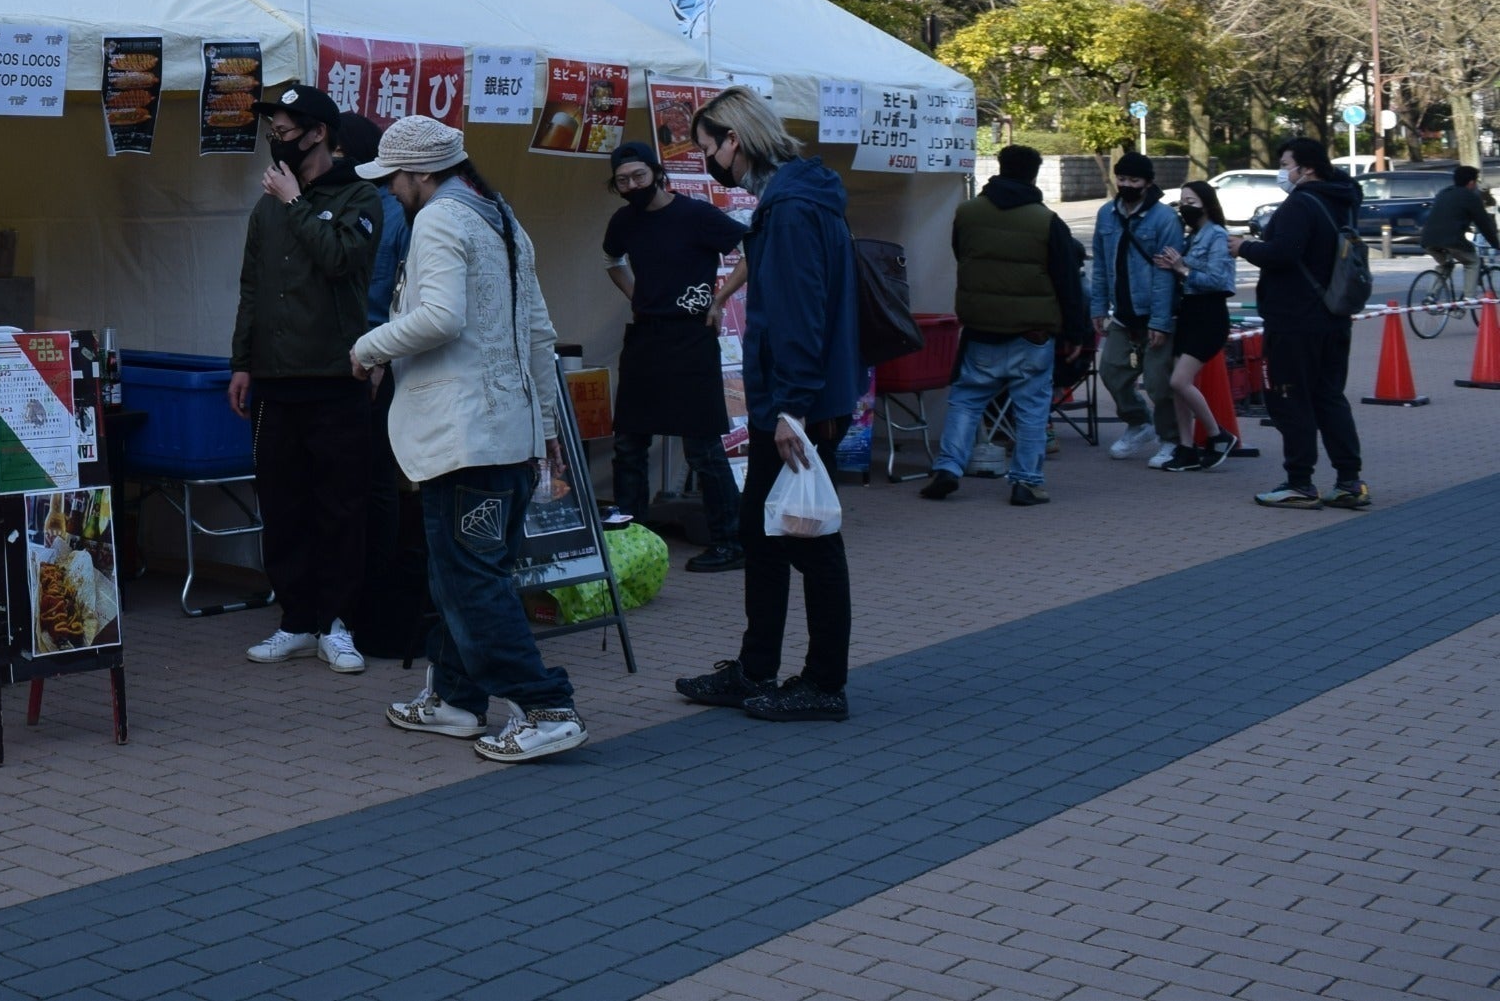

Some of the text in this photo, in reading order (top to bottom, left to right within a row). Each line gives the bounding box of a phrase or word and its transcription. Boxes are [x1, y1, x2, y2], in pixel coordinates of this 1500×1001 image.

[22, 54, 61, 67] LOCOS
[553, 67, 586, 81] 生ビール
[590, 66, 628, 79] ハイボール
[20, 75, 53, 87] DOGS
[484, 76, 523, 97] 銀結び
[327, 61, 459, 119] 銀結び
[883, 92, 918, 110] 生ビール
[824, 106, 858, 118] HIGHBURY
[584, 114, 625, 125] レモンサワー
[873, 110, 918, 129] ハイボール
[861, 129, 916, 148] レモンサワー
[889, 154, 917, 169] ¥500
[927, 154, 952, 167] ビール
[28, 338, 55, 350] タコス
[38, 350, 65, 362] ロコス
